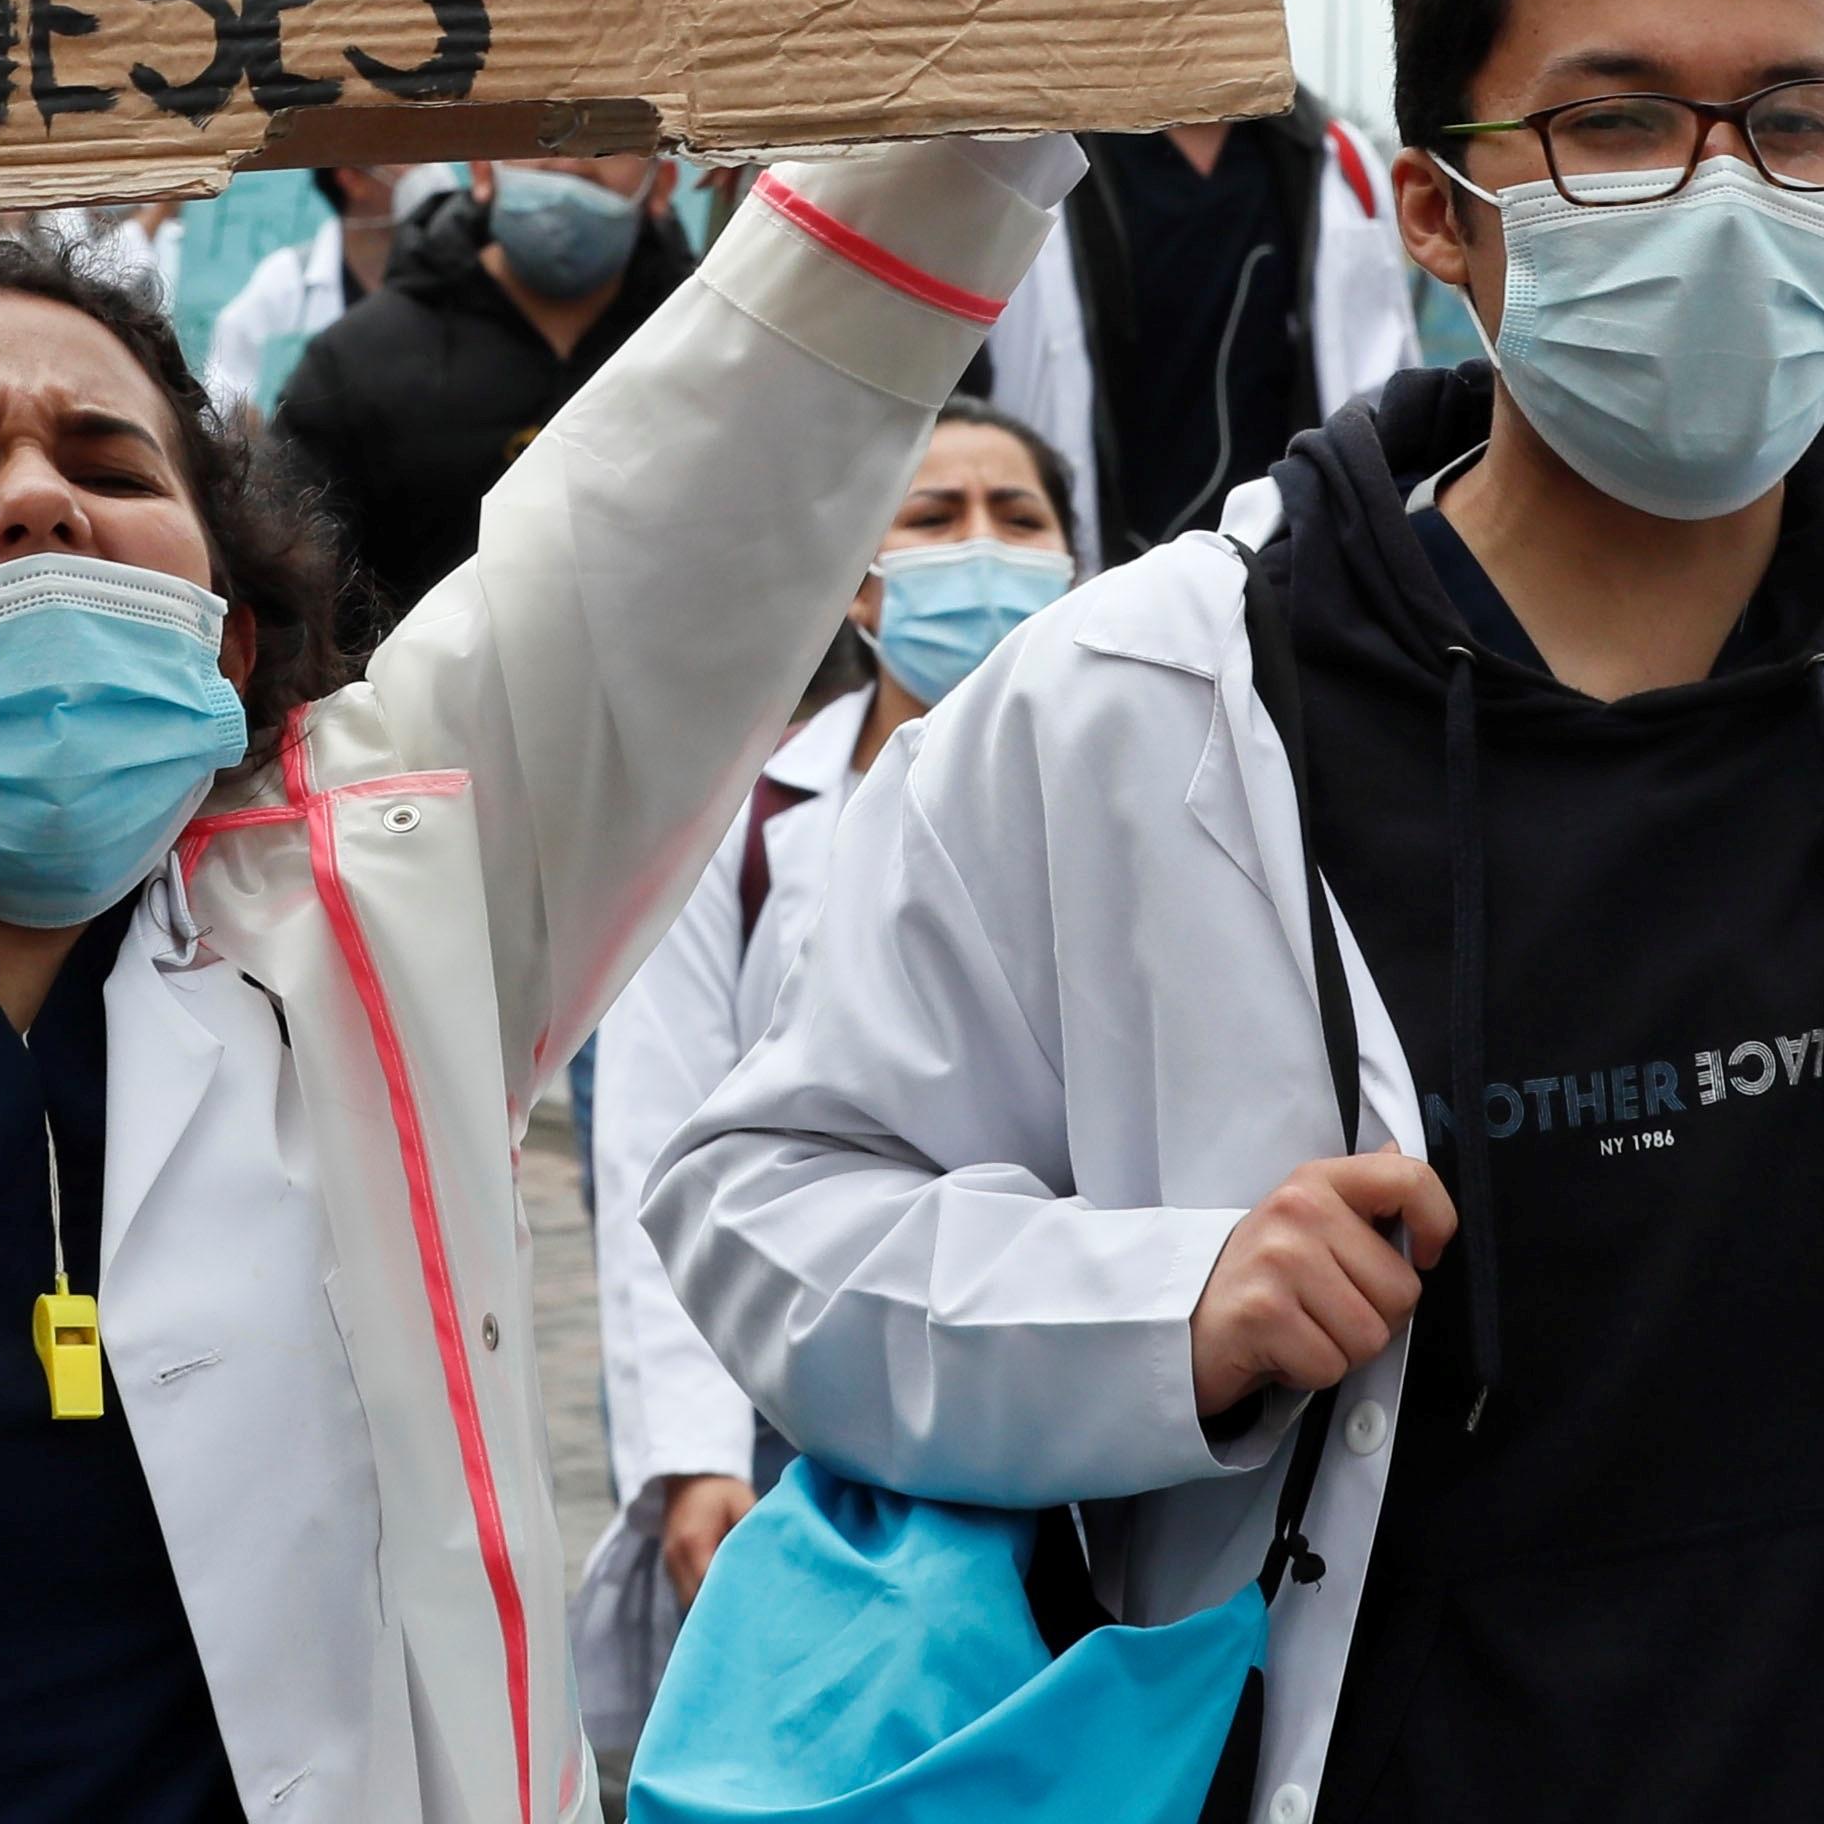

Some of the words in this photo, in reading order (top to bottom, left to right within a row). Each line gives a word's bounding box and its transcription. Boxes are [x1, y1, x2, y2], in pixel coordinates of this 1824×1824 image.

[1423, 1060, 1687, 1146] NOTHER
[1601, 1137, 1624, 1156] NY
[1632, 1129, 1675, 1152] 1986
